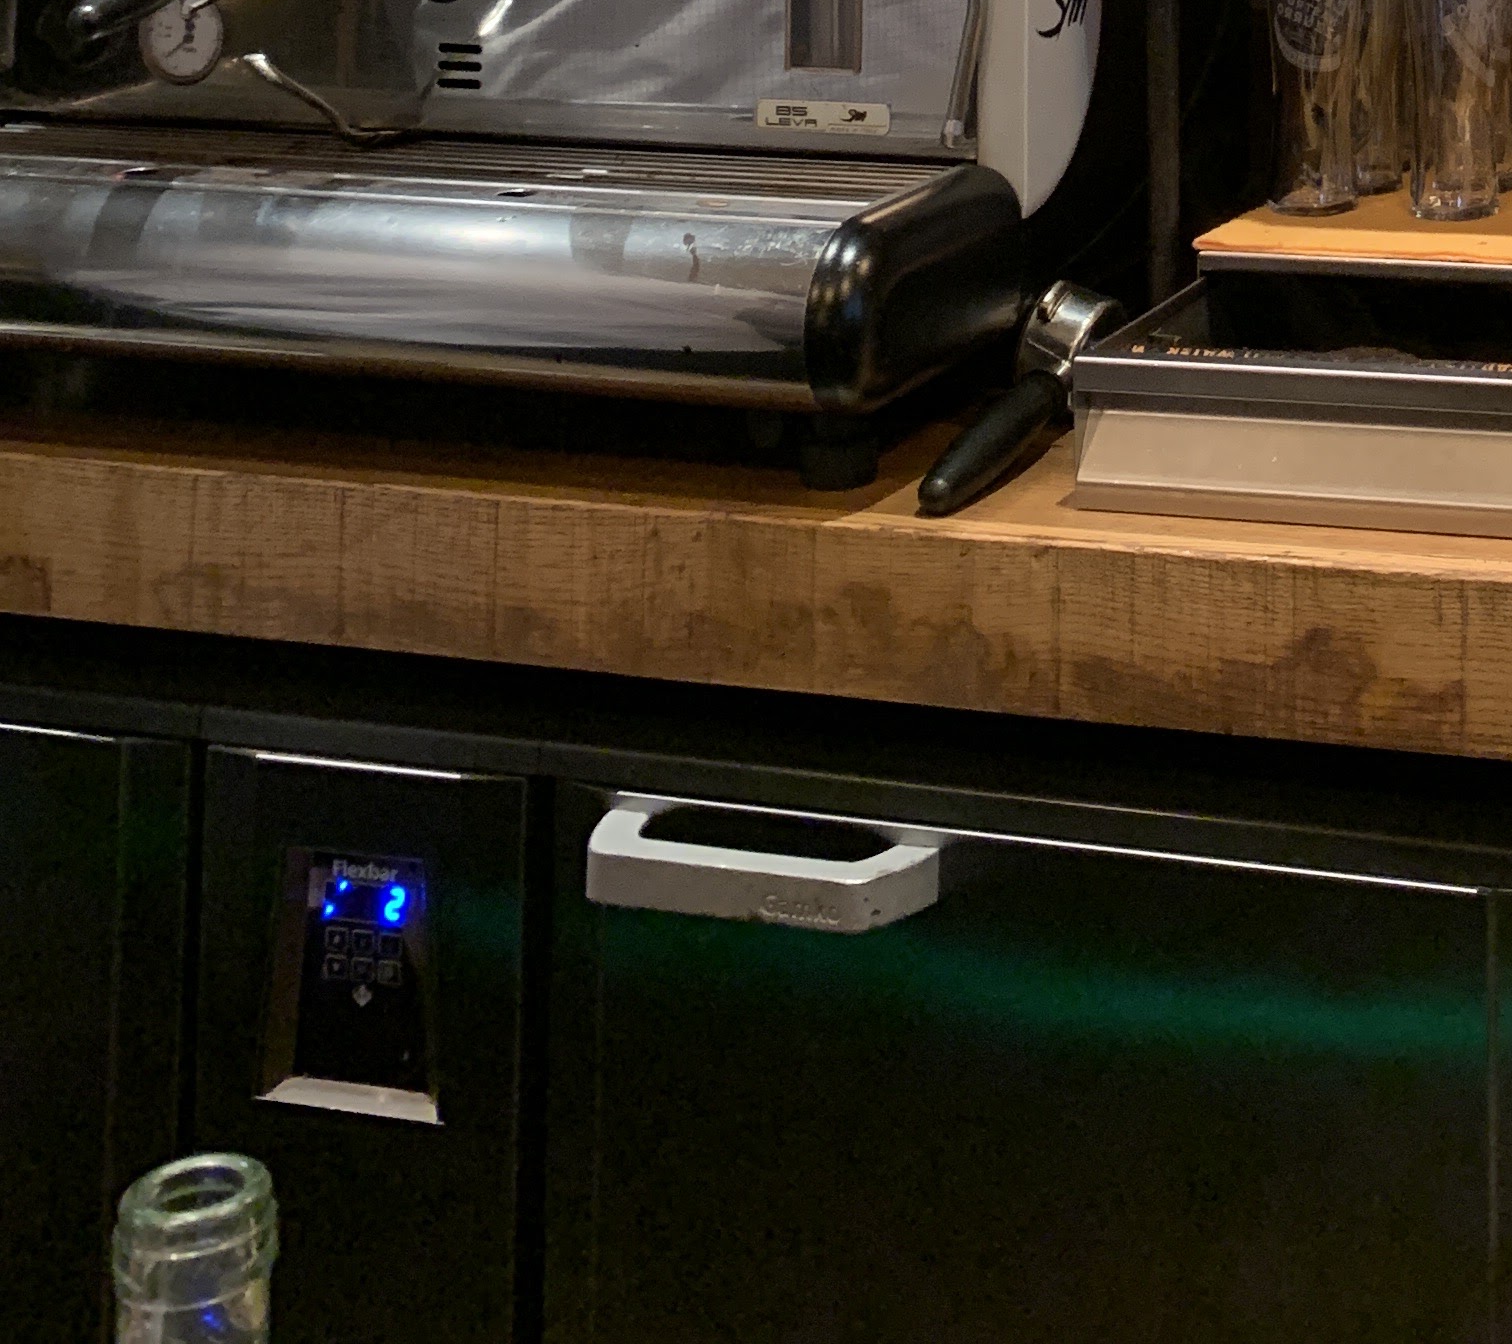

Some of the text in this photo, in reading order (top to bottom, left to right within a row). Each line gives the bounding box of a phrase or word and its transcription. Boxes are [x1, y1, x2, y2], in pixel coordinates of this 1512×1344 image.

[775, 105, 808, 117] BS
[764, 116, 818, 128] LEVA
[332, 859, 399, 882] Flexbar
